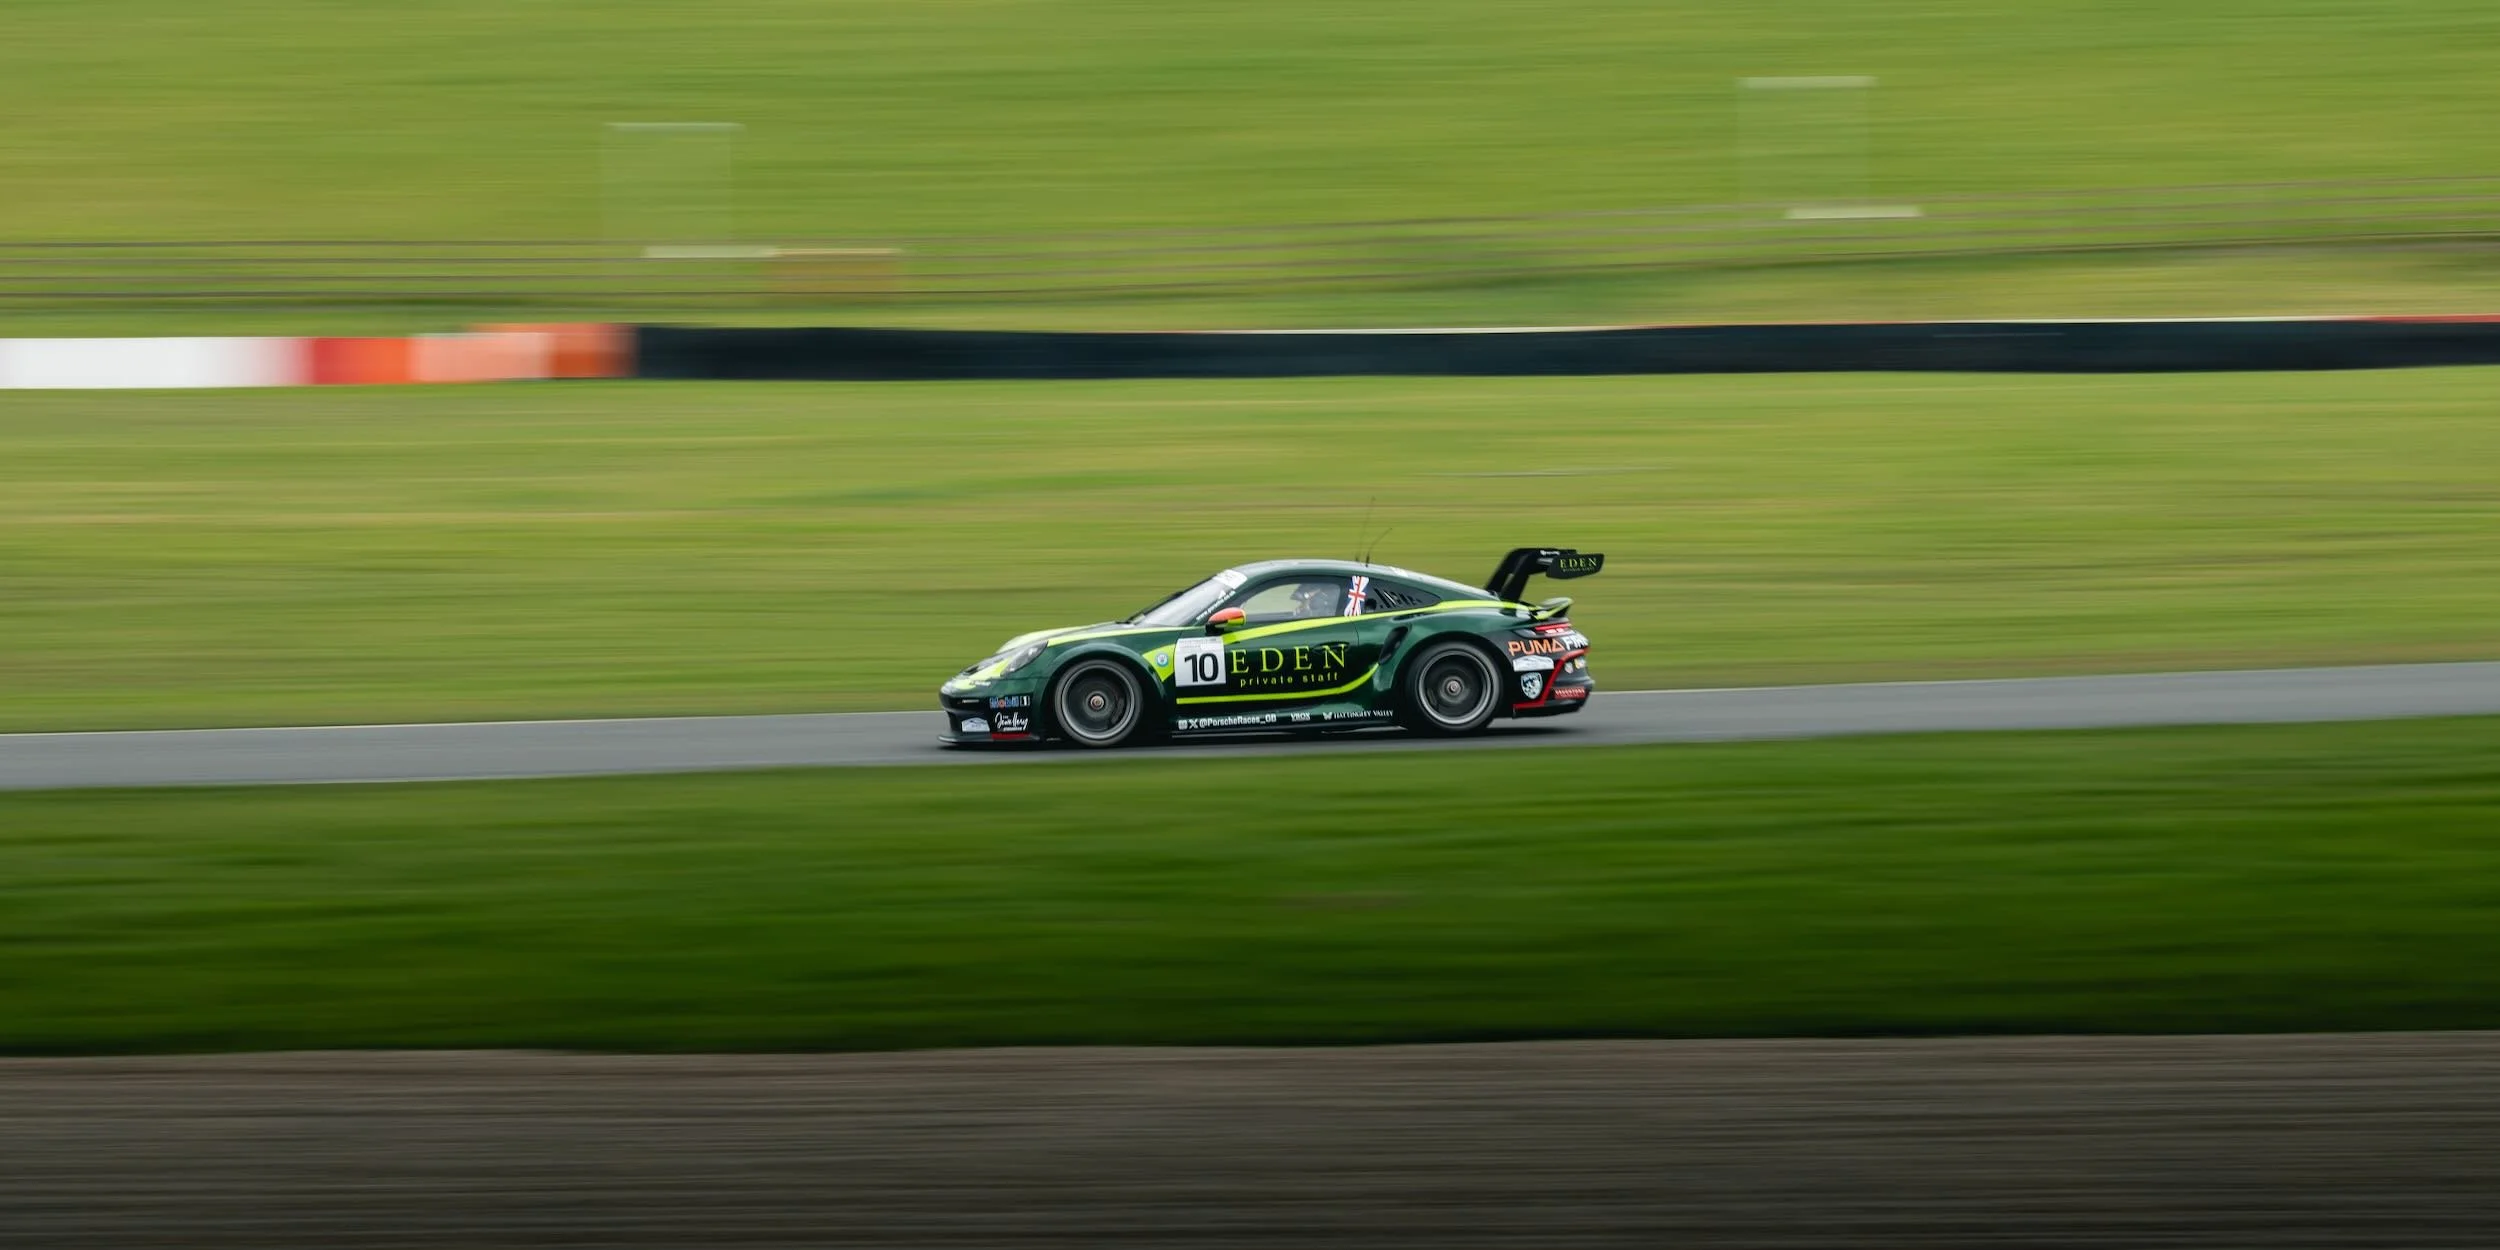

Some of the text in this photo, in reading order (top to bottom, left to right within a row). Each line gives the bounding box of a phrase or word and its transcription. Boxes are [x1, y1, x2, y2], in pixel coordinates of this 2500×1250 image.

[1560, 558, 1596, 568] EDEN
[1508, 638, 1566, 657] PUMA
[1231, 643, 1346, 673] EDEN
[1184, 653, 1219, 683] 10
[1240, 672, 1339, 688] private staff
